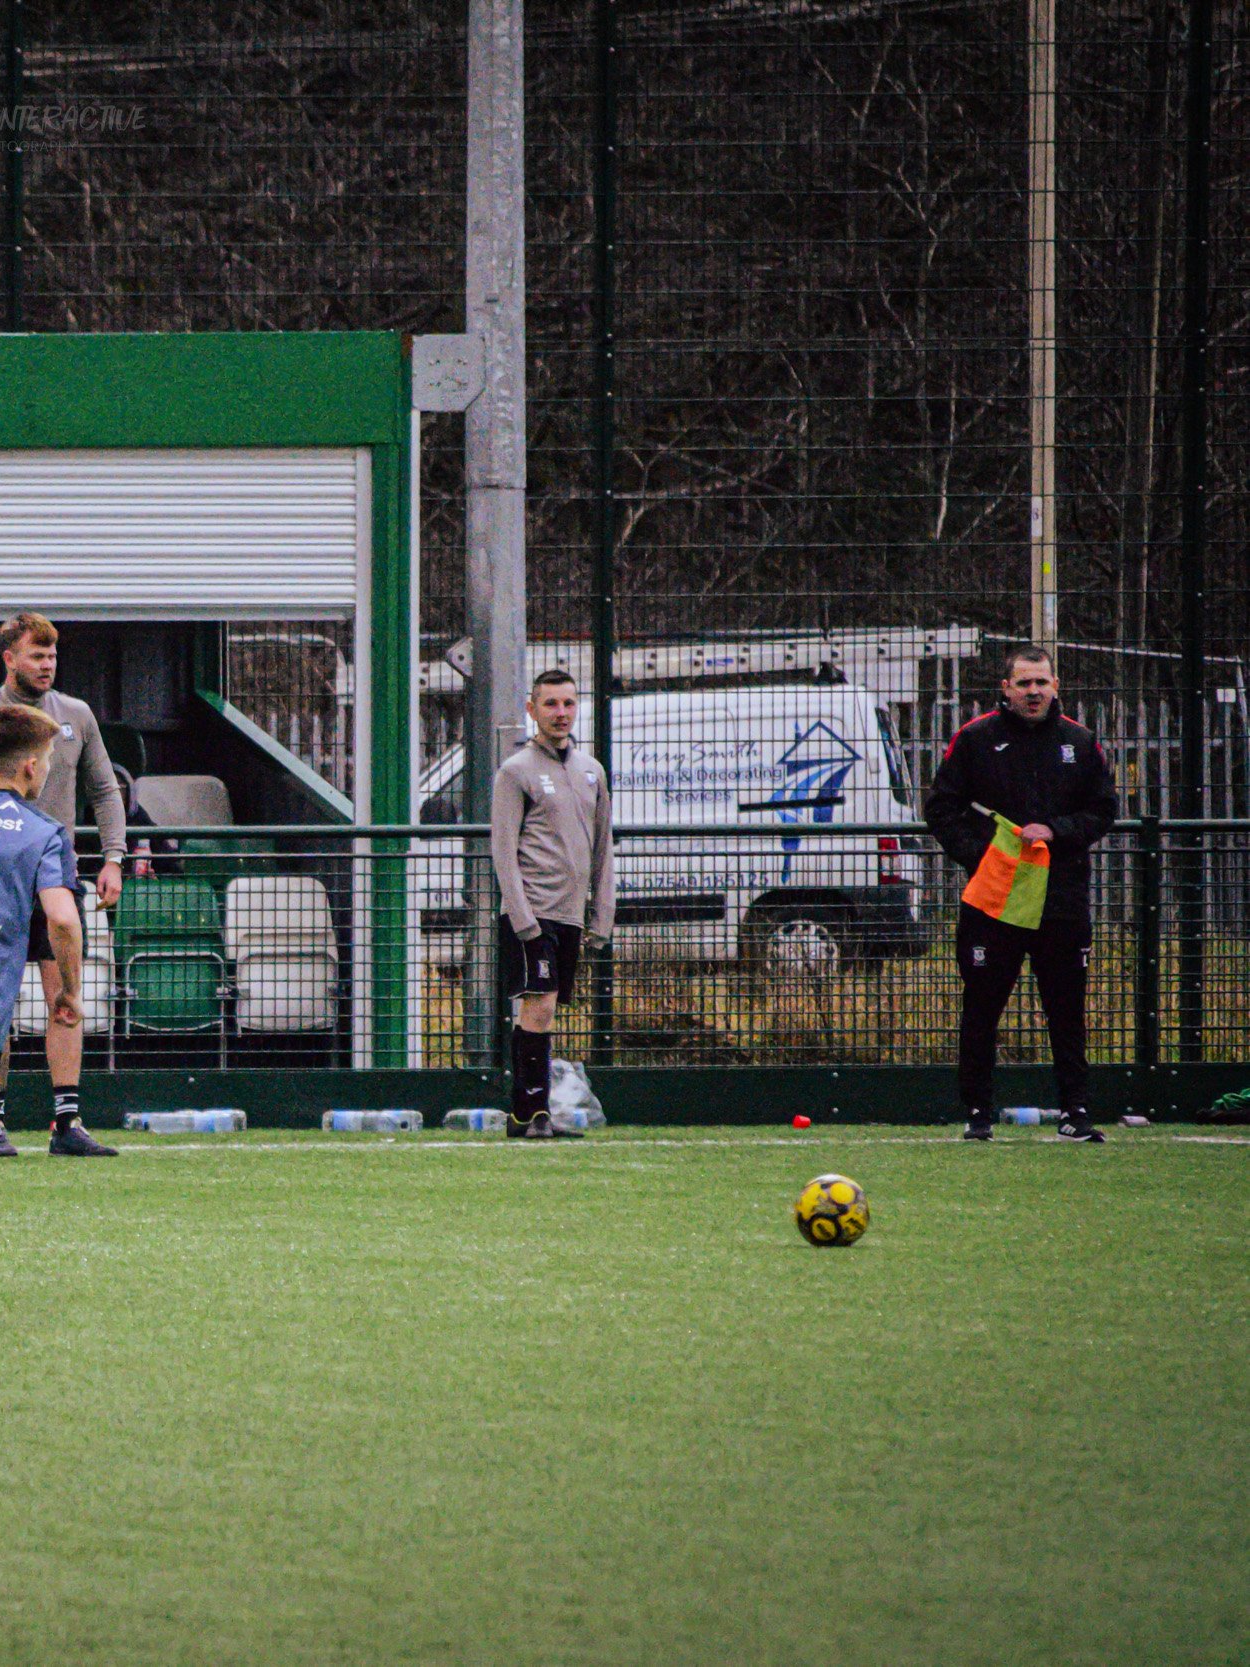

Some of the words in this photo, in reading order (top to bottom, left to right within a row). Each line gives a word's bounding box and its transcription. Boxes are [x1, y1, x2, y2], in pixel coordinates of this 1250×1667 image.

[629, 741, 687, 771] Terry
[691, 740, 760, 763] Smith
[613, 772, 675, 788] Painting
[680, 770, 693, 784] &
[696, 767, 783, 782] Decorating
[664, 789, 732, 804] Services
